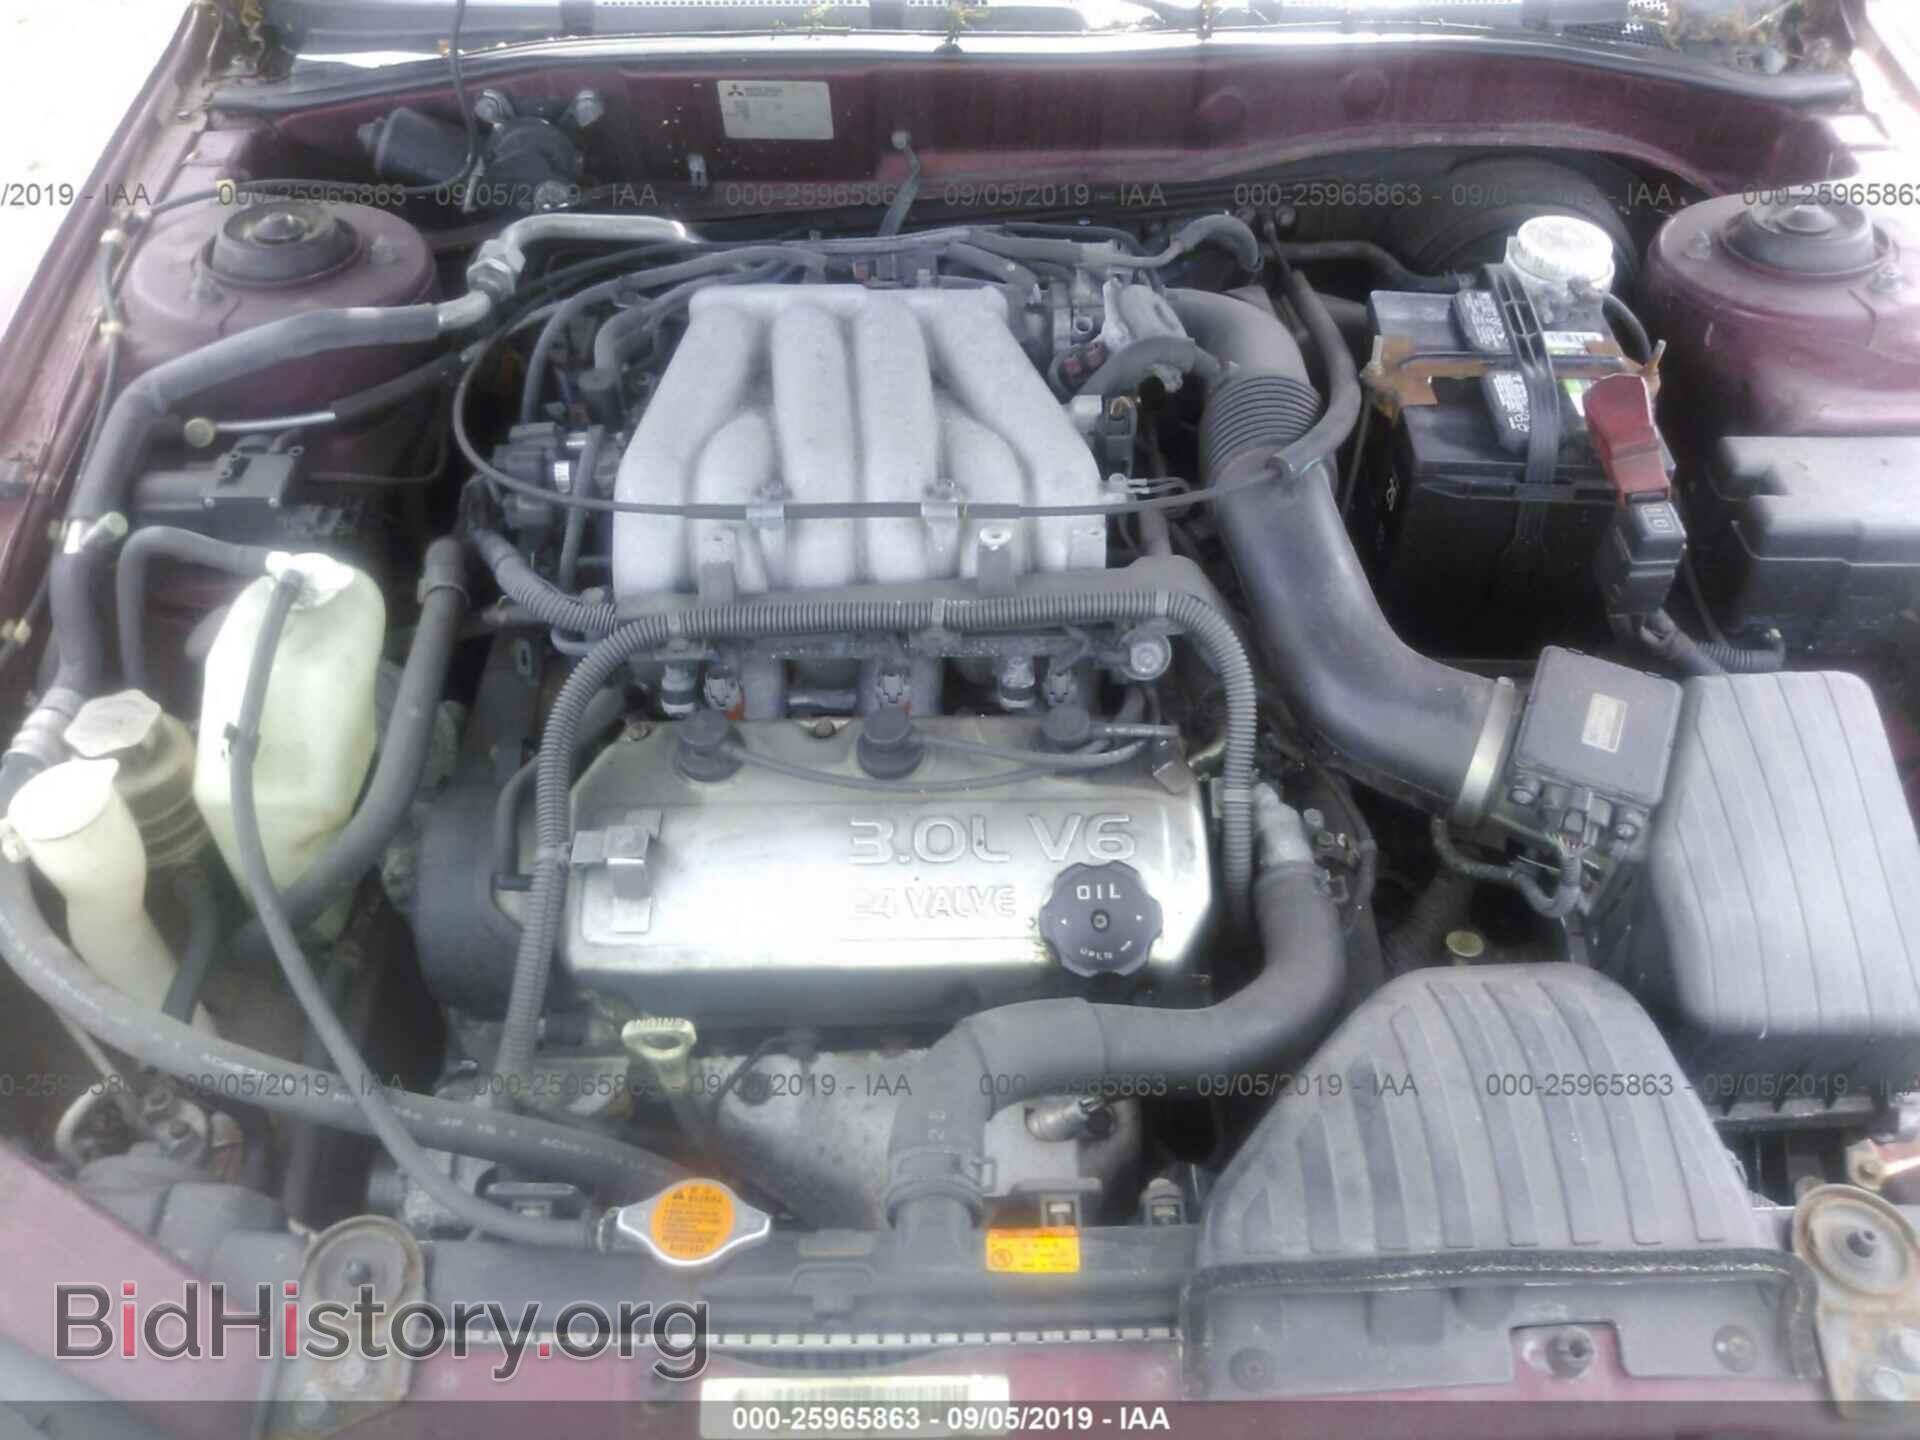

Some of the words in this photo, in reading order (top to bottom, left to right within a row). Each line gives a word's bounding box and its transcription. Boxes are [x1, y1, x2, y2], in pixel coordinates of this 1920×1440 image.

[848, 813, 1011, 865] 3.0L
[1026, 812, 1137, 862] V6
[905, 884, 1018, 919] VALVE
[1076, 882, 1122, 901] OIL
